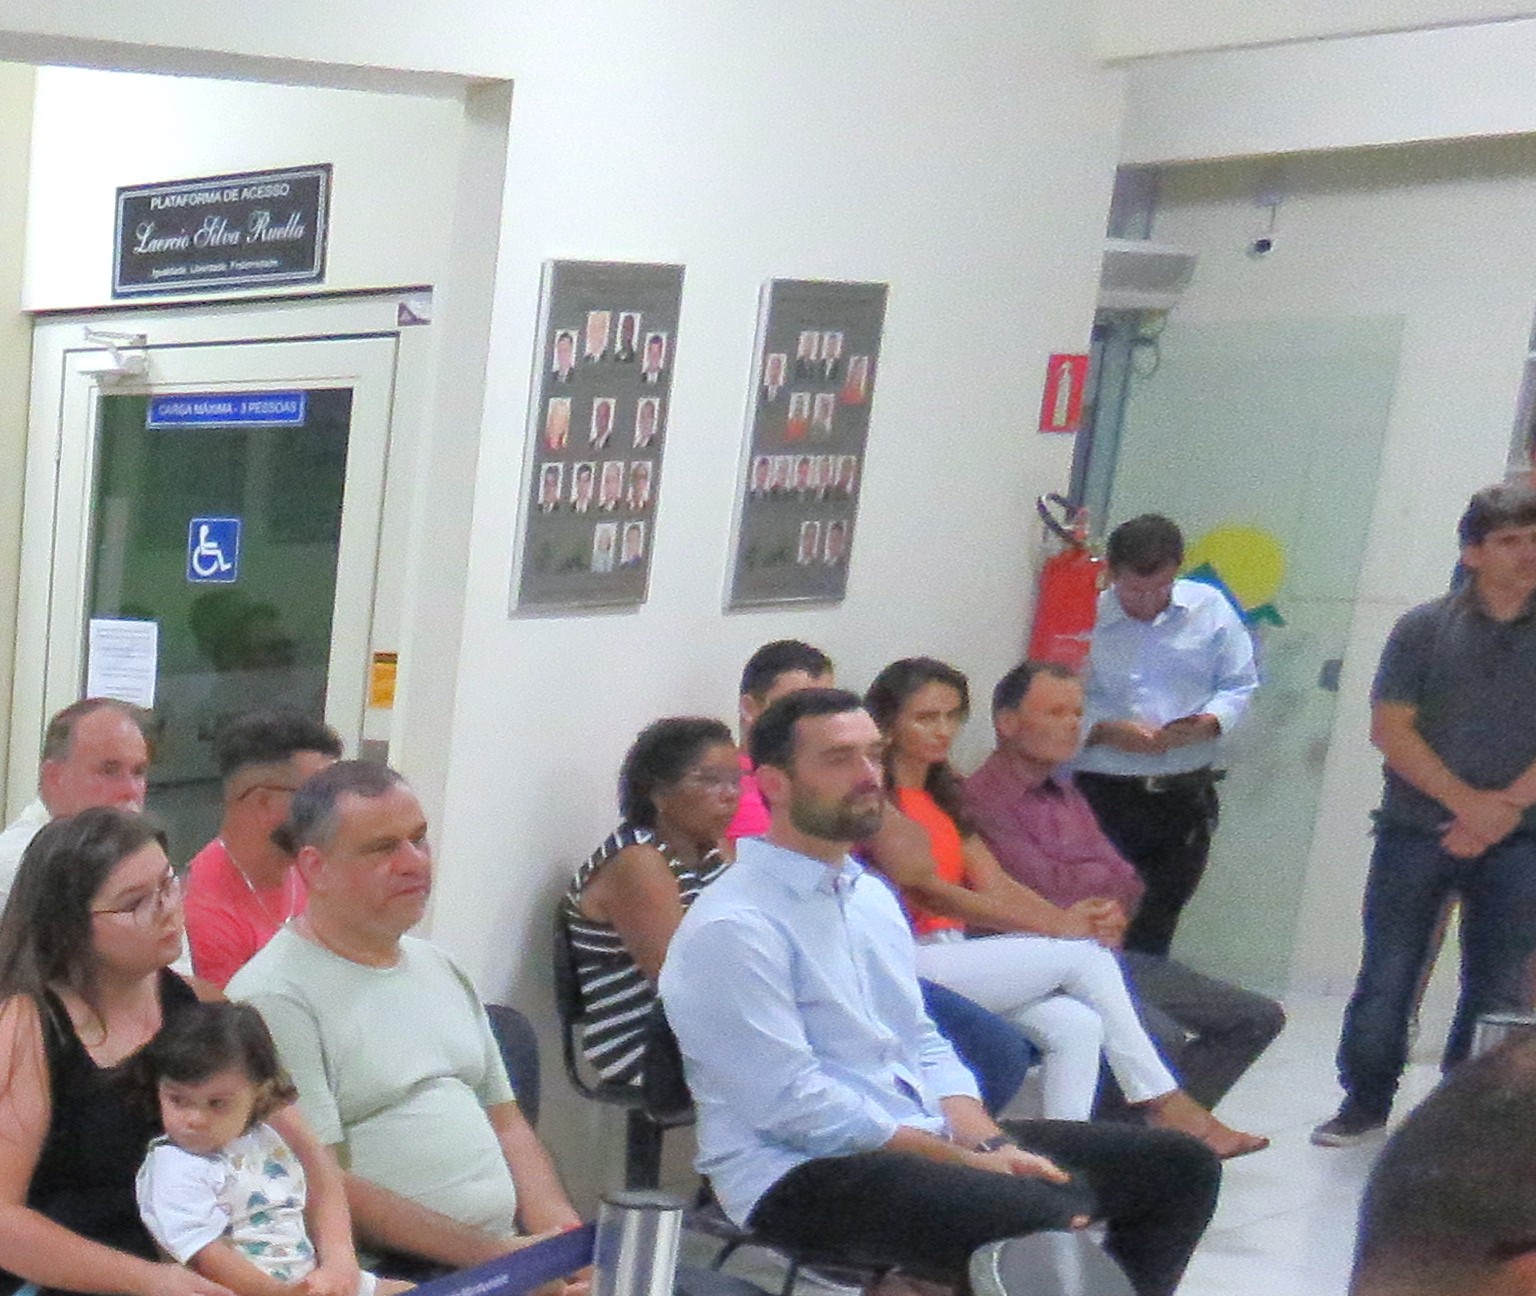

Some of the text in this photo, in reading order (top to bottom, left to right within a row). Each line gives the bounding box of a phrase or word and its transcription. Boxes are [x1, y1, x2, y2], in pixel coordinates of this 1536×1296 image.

[150, 183, 290, 211] PLATAFORMA DE ACESSO
[133, 209, 306, 254] Laercio Silva Ruella
